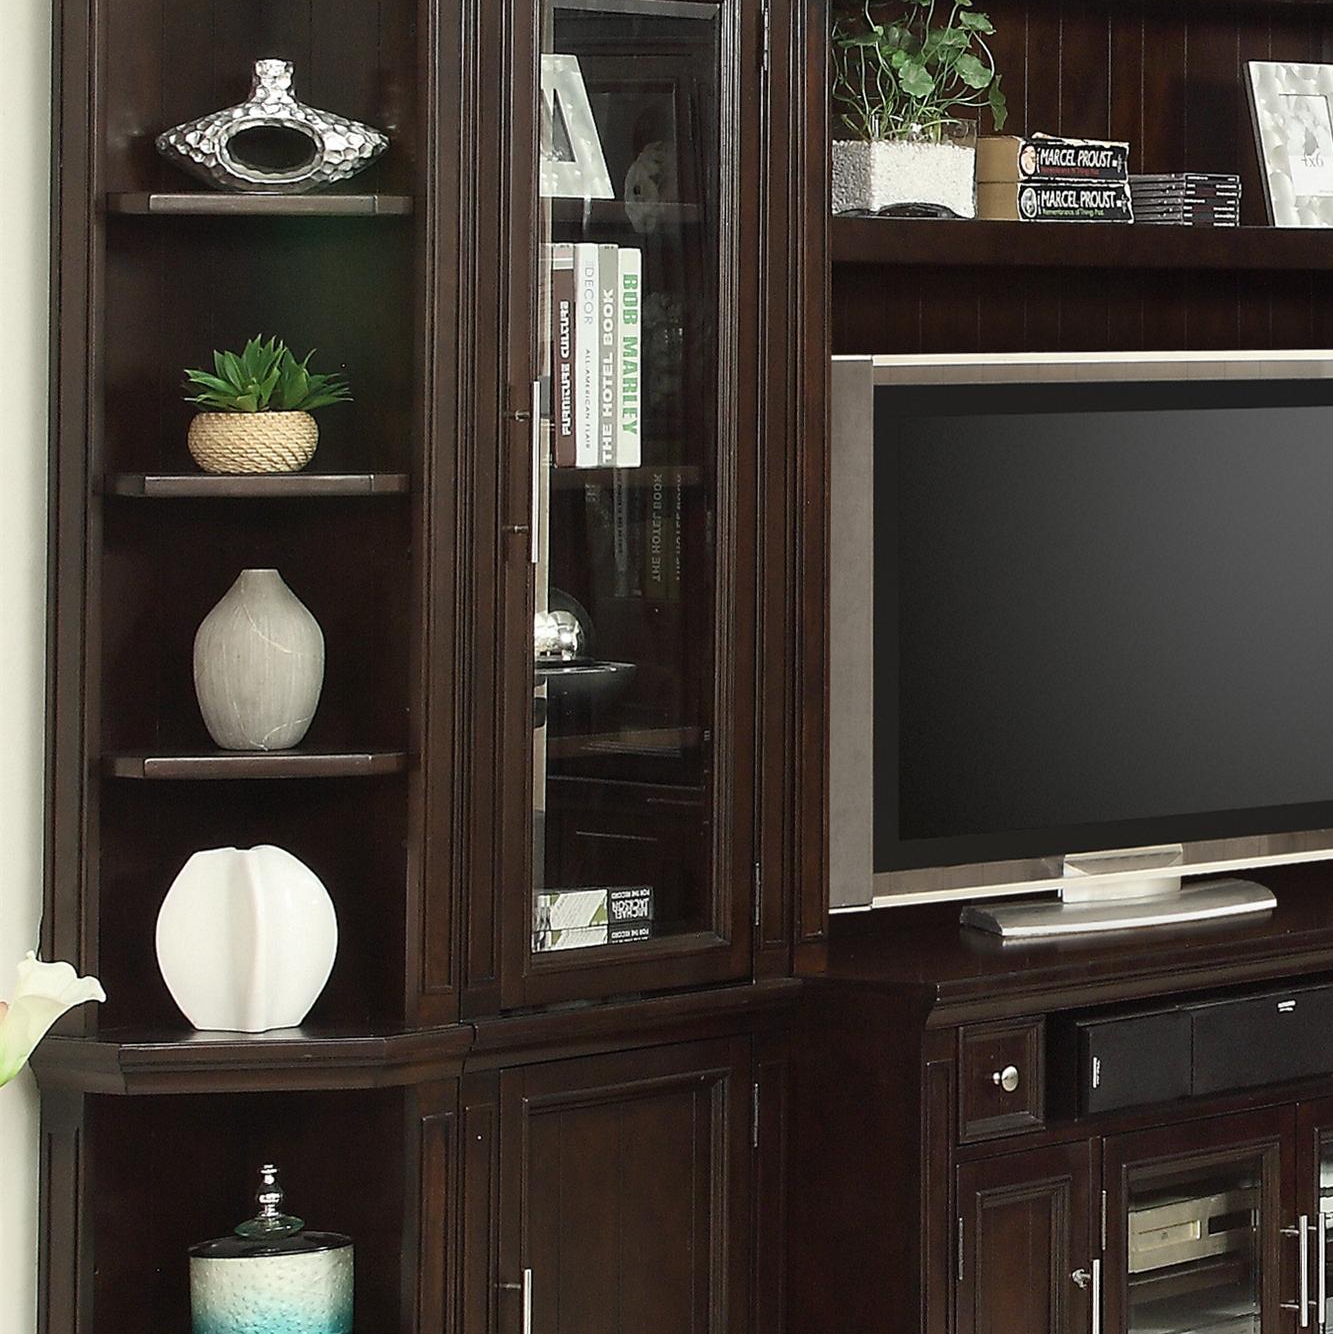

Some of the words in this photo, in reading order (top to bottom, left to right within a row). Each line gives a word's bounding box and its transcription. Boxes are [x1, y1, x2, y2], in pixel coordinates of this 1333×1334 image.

[1040, 149, 1077, 166] MARCEL
[1077, 150, 1113, 168] PROUST
[1041, 190, 1079, 208] MARCEL
[1080, 191, 1117, 208] PROUST
[603, 288, 614, 346] BOOK
[623, 274, 638, 325] BOB
[602, 352, 614, 417] HOTEL
[622, 336, 638, 436] MARLEY
[602, 424, 613, 465] THE
